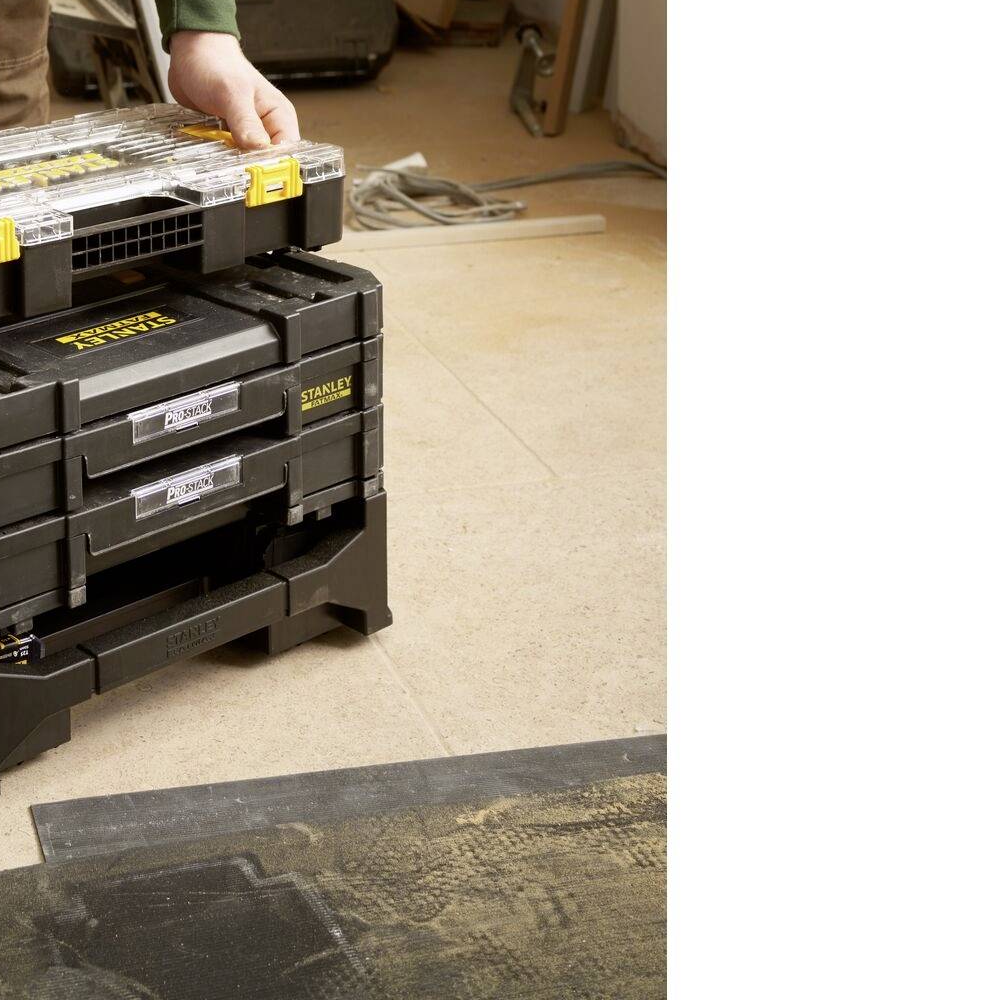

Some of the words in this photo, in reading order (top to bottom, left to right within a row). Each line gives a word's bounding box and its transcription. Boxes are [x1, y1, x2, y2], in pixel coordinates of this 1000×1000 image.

[72, 316, 176, 350] STANLEY
[301, 376, 352, 402] STANLEY
[167, 473, 214, 501] PRO-STACK
